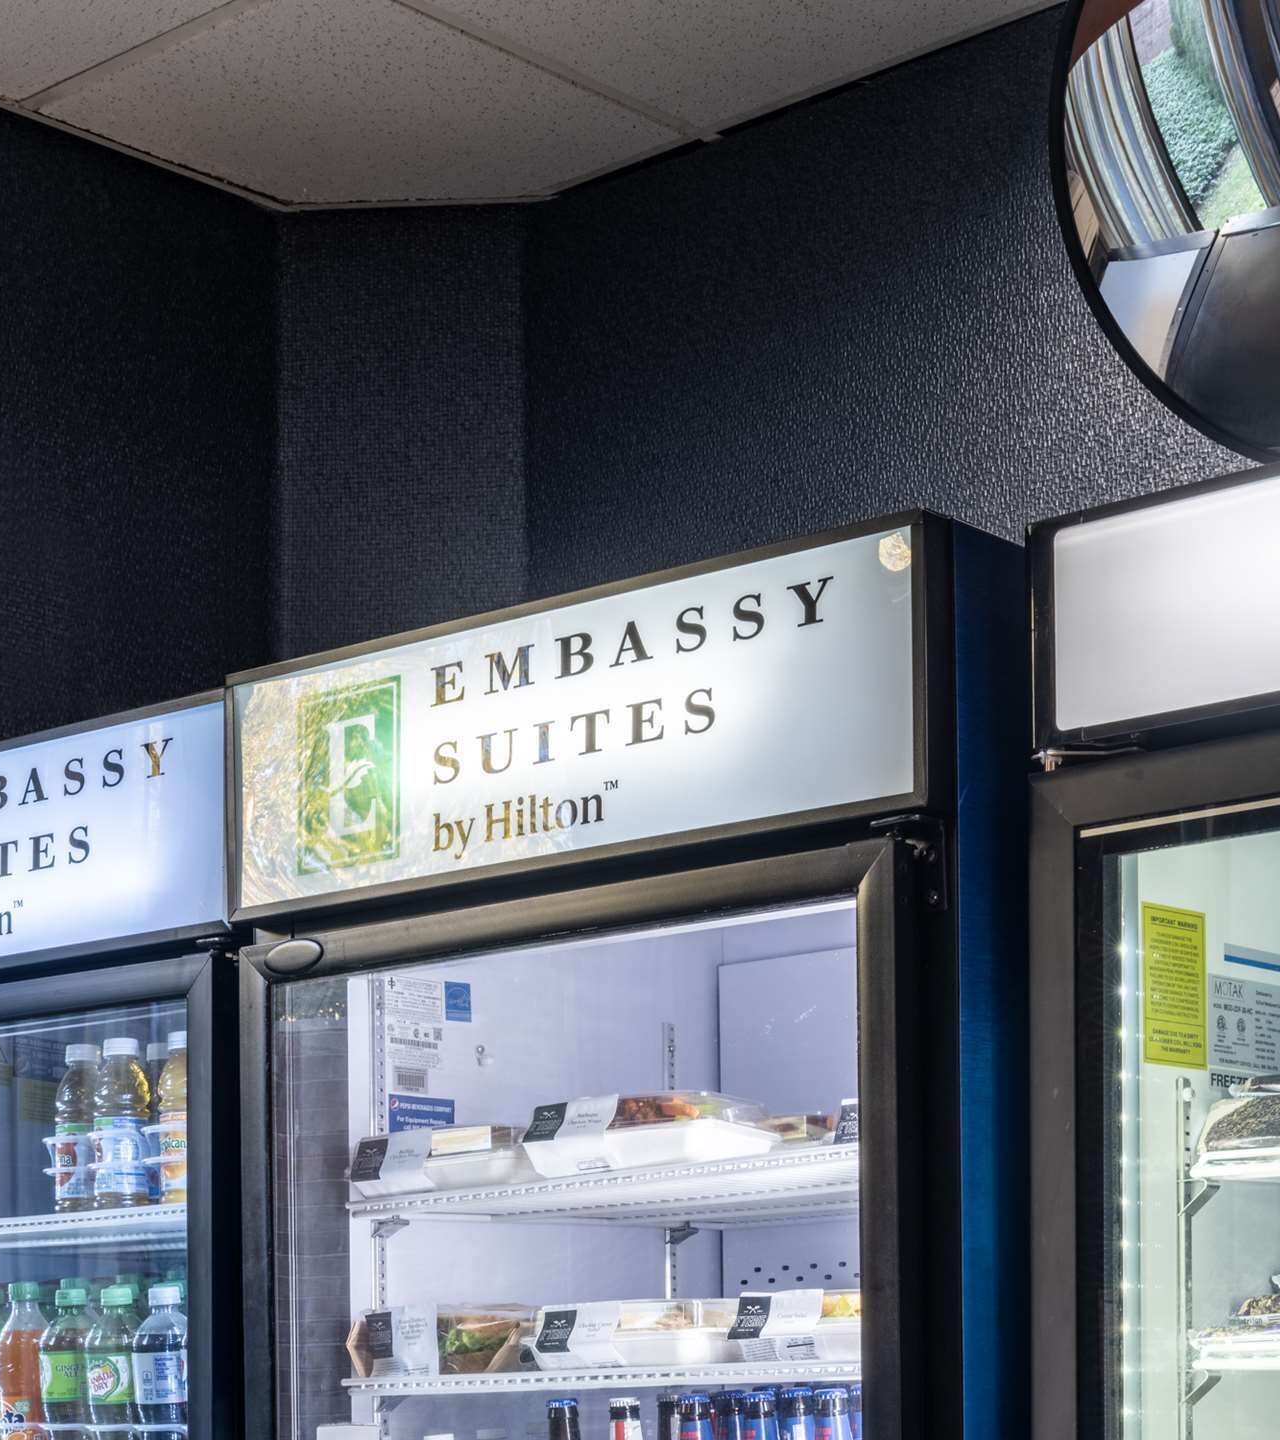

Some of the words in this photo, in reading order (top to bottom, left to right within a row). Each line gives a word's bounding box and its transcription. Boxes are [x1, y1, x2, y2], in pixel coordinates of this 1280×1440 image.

[430, 576, 833, 707] EMBASSY
[433, 688, 716, 785] SUITES
[432, 812, 475, 859] by
